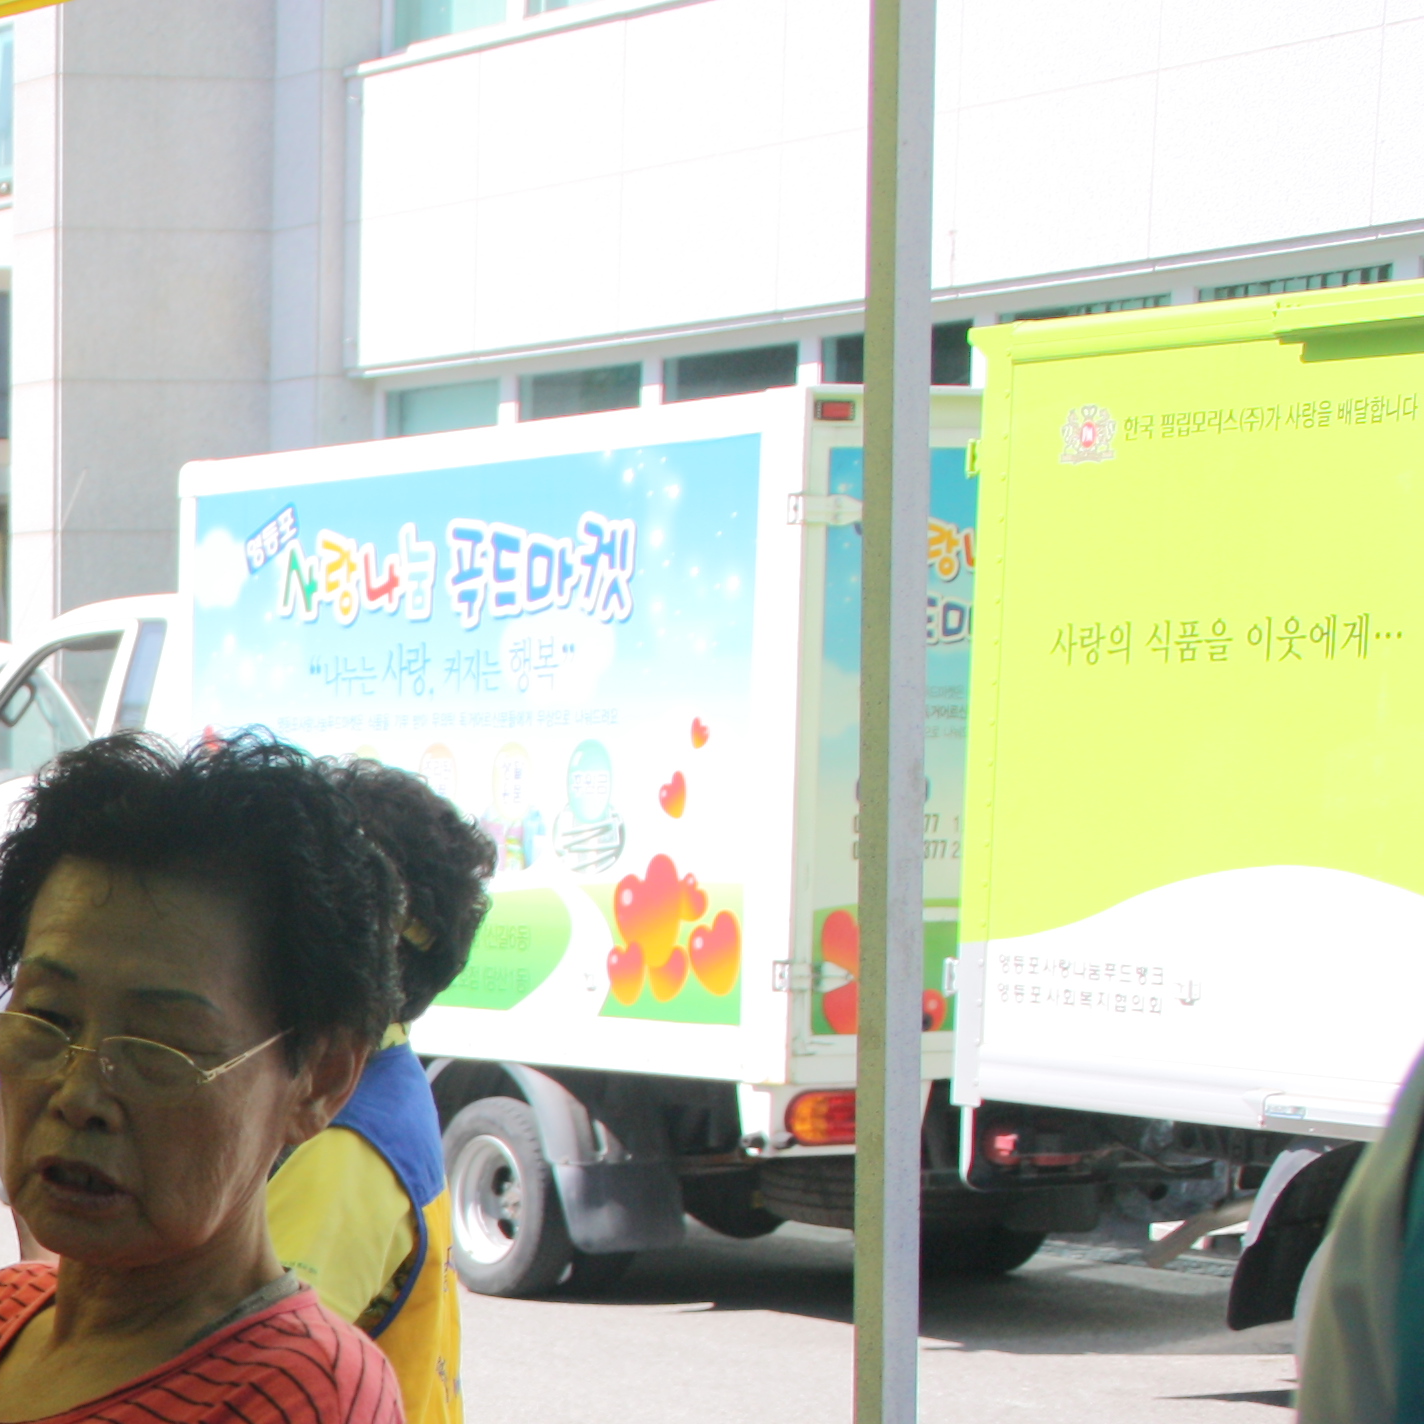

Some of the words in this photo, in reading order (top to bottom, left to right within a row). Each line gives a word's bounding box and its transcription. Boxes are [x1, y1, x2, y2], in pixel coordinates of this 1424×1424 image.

[1123, 414, 1155, 442] 한국
[1160, 405, 1281, 439] 필립모리스(주)가
[1285, 400, 1333, 431] 사랑을
[1336, 393, 1419, 426] 배달합니다
[248, 506, 299, 567] 영등포
[281, 524, 435, 623] 사랑나눔
[449, 513, 635, 627] 푸드마켓
[1050, 620, 1132, 666] 사랑의
[1145, 617, 1234, 664] 식품을
[443, 648, 503, 693] 커지는
